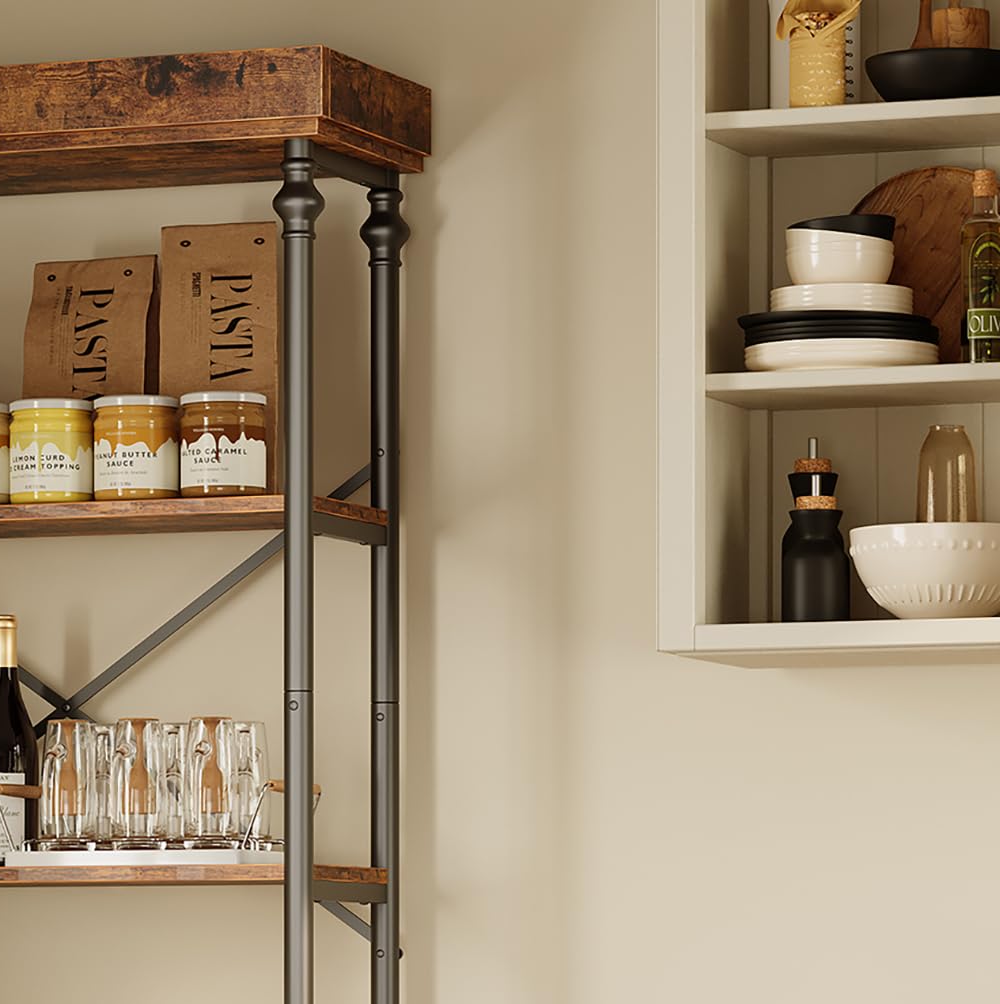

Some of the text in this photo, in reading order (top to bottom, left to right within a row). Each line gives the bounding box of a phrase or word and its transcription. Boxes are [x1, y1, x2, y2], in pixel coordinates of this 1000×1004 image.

[191, 272, 202, 298] SPAGHETTI
[209, 273, 253, 381] PASTA
[40, 463, 81, 471] TOPPING
